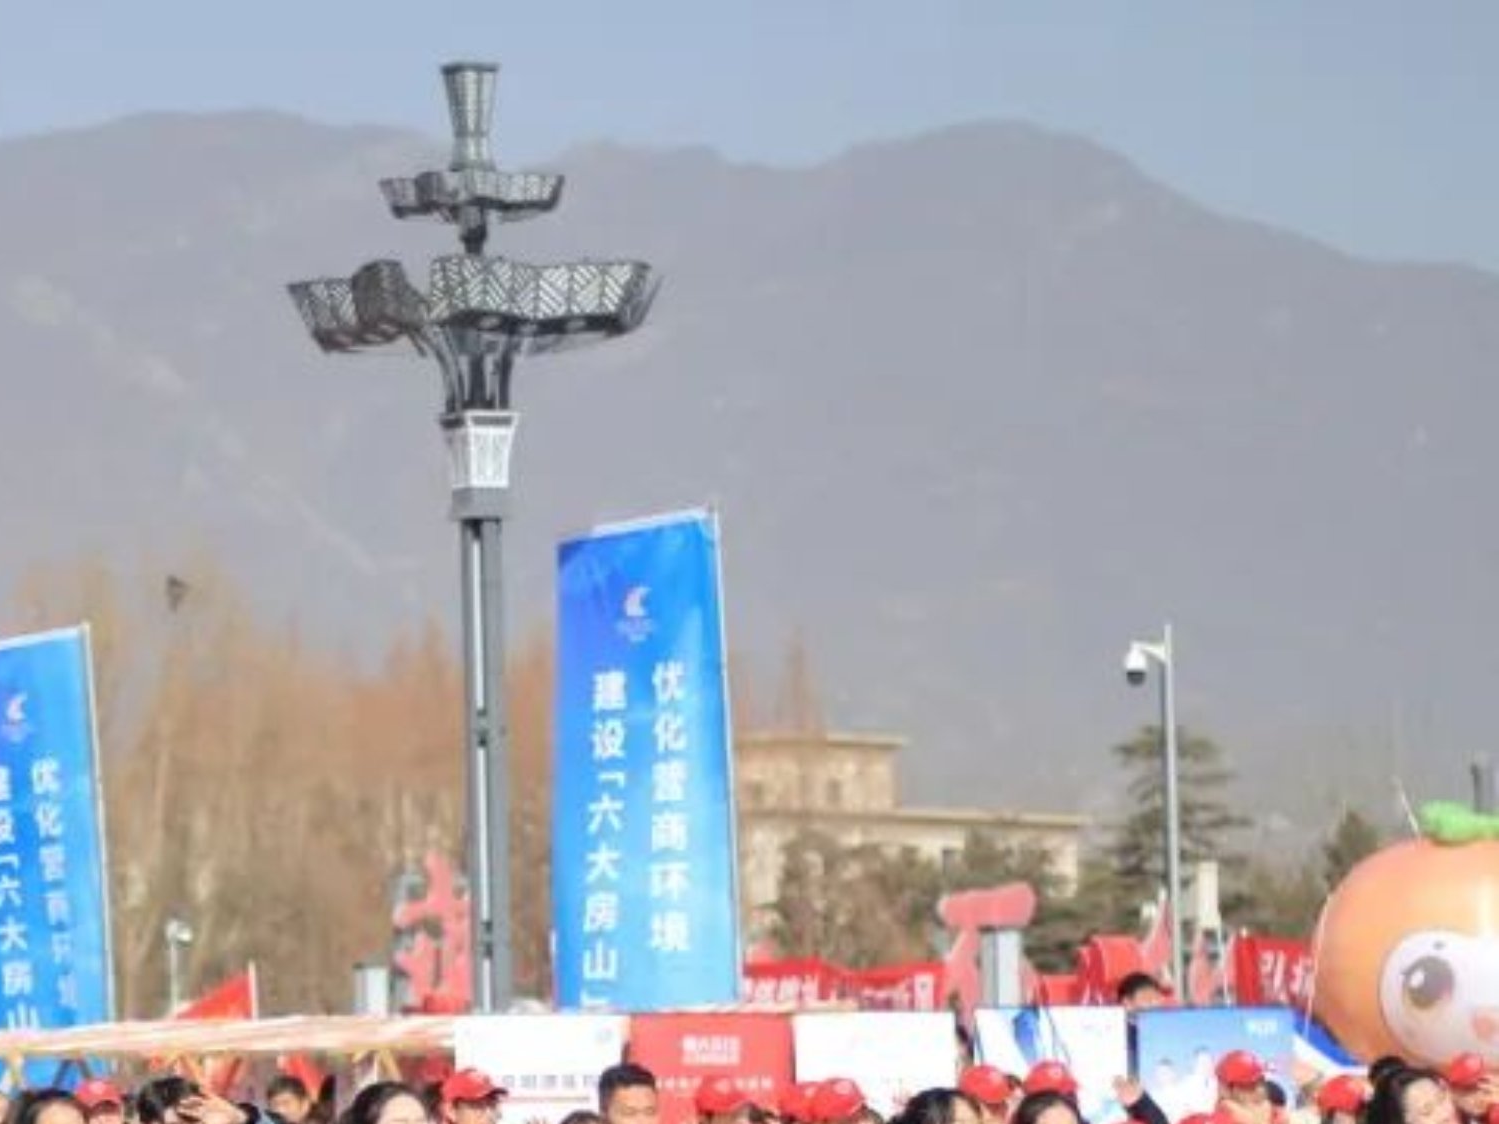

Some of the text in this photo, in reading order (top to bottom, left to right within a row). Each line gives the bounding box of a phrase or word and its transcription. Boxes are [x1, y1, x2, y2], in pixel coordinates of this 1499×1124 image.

[652, 661, 690, 951] 优化营商环境
